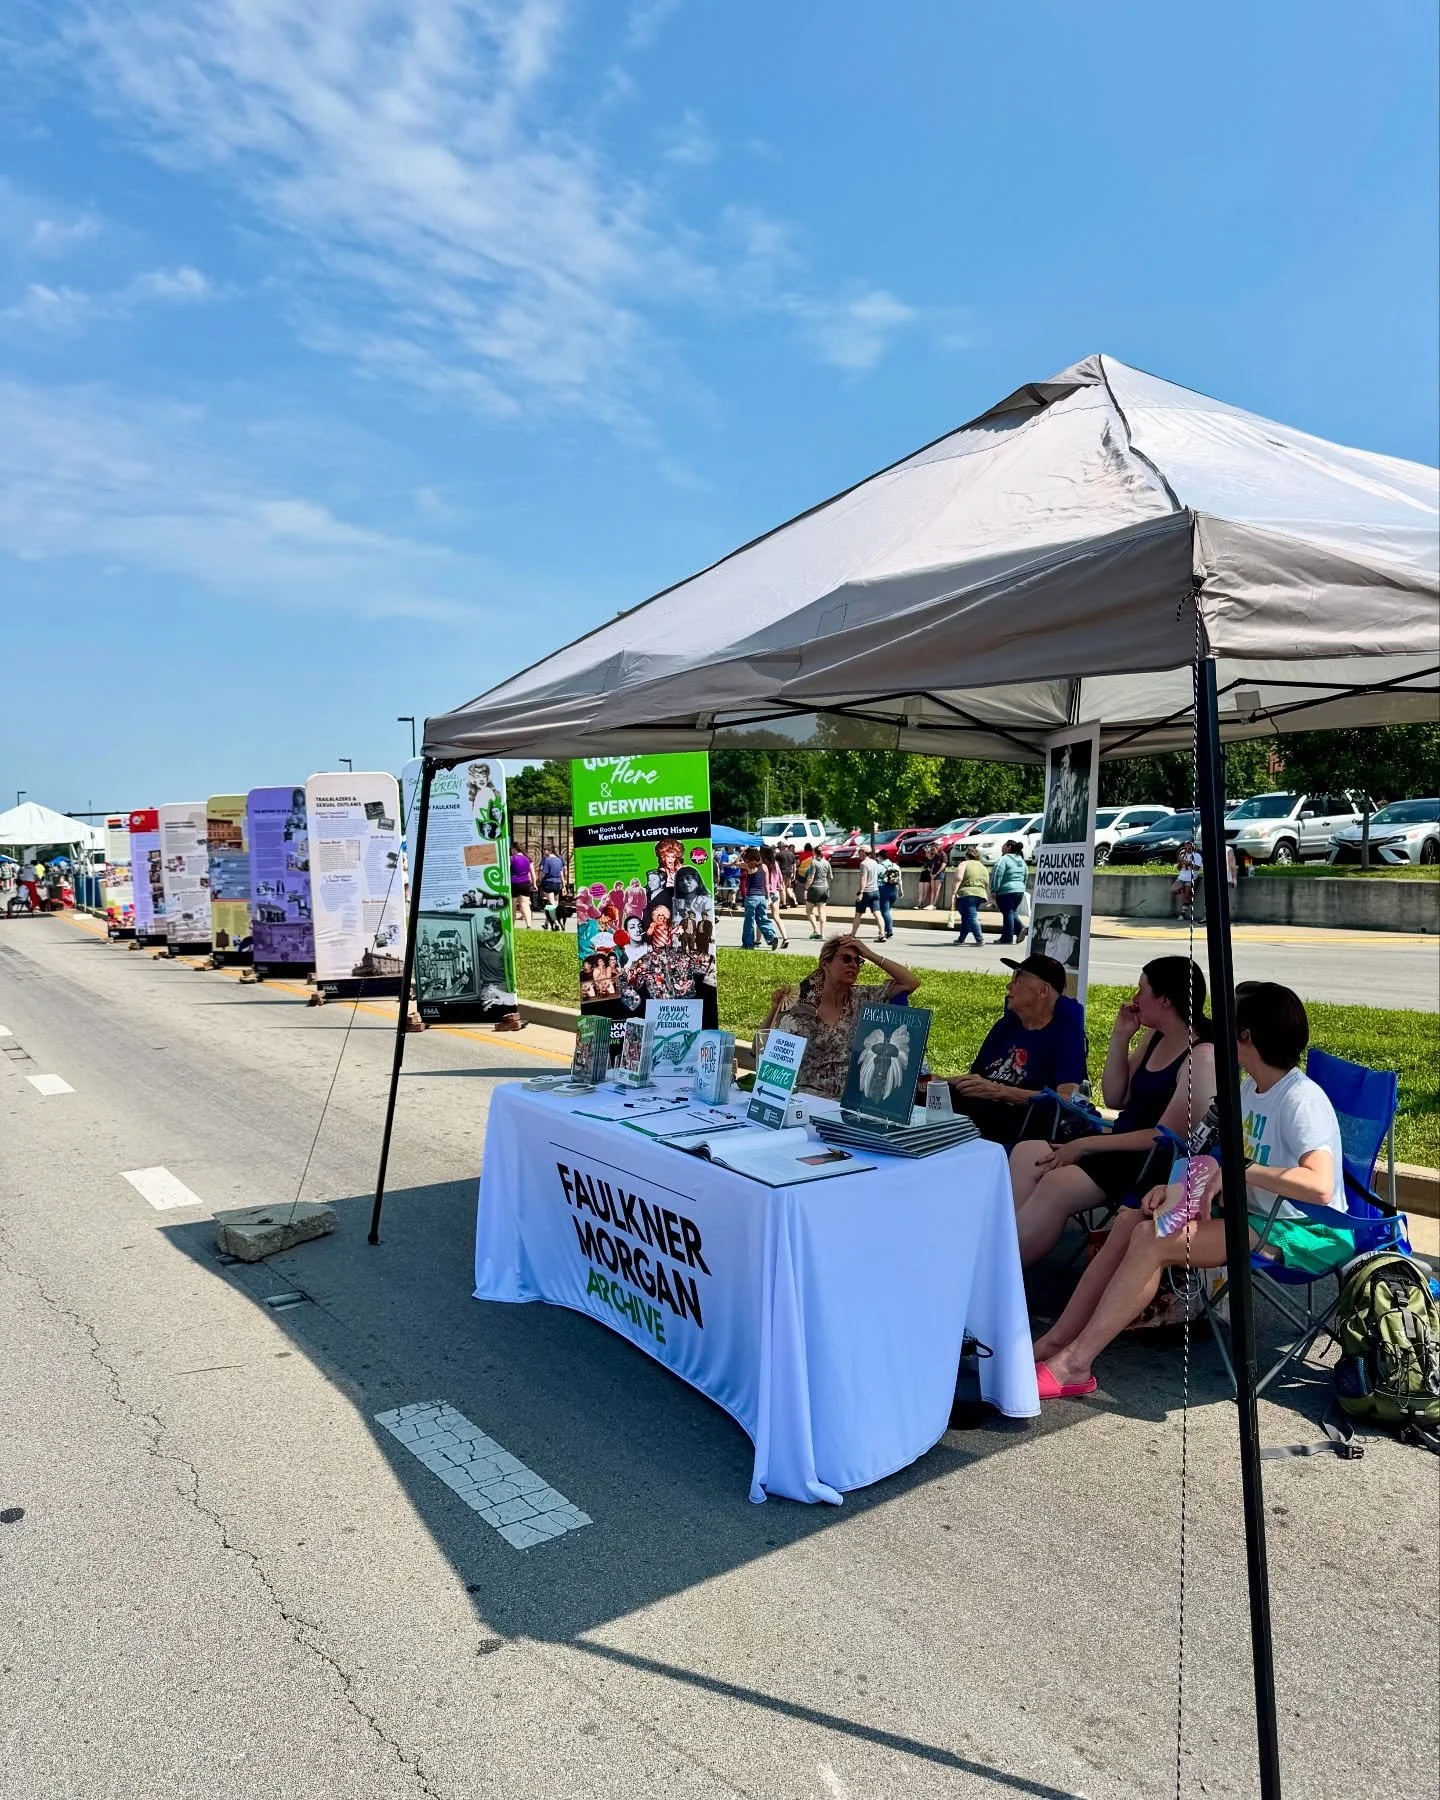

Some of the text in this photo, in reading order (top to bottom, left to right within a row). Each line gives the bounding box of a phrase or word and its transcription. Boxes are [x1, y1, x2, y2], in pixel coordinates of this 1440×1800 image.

[610, 760, 660, 785] Here
[600, 781, 613, 798] &
[432, 803, 461, 811] FAULKNER
[588, 795, 694, 817] EVERYWHERE
[598, 826, 698, 841] Kentucky's LGBTQ History
[599, 825, 617, 833] Roots
[1038, 852, 1085, 869] FAULKNER
[1036, 870, 1080, 887] MORGAN
[1036, 887, 1066, 900] ARCHIVE
[656, 1011, 690, 1030] your
[862, 1007, 892, 1023] PAGAN
[657, 1021, 689, 1029] FEEDBACK
[761, 1064, 793, 1085] DONATE
[556, 1162, 713, 1277] FAULKNER
[572, 1214, 704, 1330] MORGAN
[586, 1266, 667, 1347] ARCHIVE
